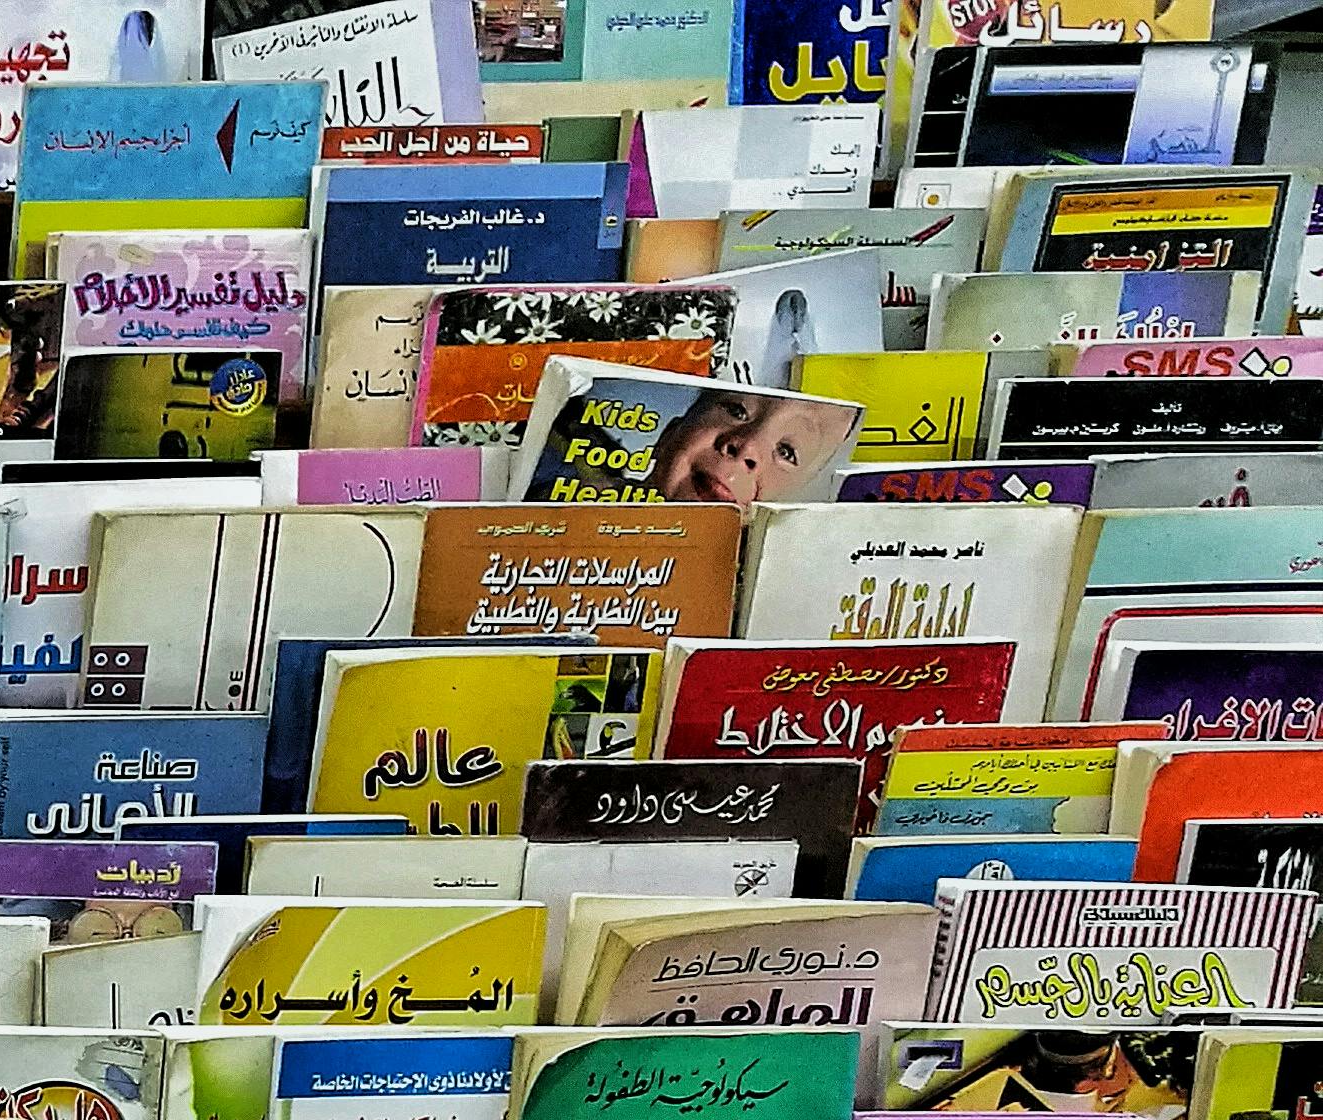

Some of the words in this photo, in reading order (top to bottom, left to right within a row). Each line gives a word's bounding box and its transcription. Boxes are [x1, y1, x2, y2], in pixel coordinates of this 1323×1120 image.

[340, 131, 393, 153] الحب
[443, 134, 470, 156] من
[477, 131, 529, 154] حياة
[582, 399, 659, 432] Kids
[565, 439, 654, 473] Food
[94, 750, 198, 781] صناعة
